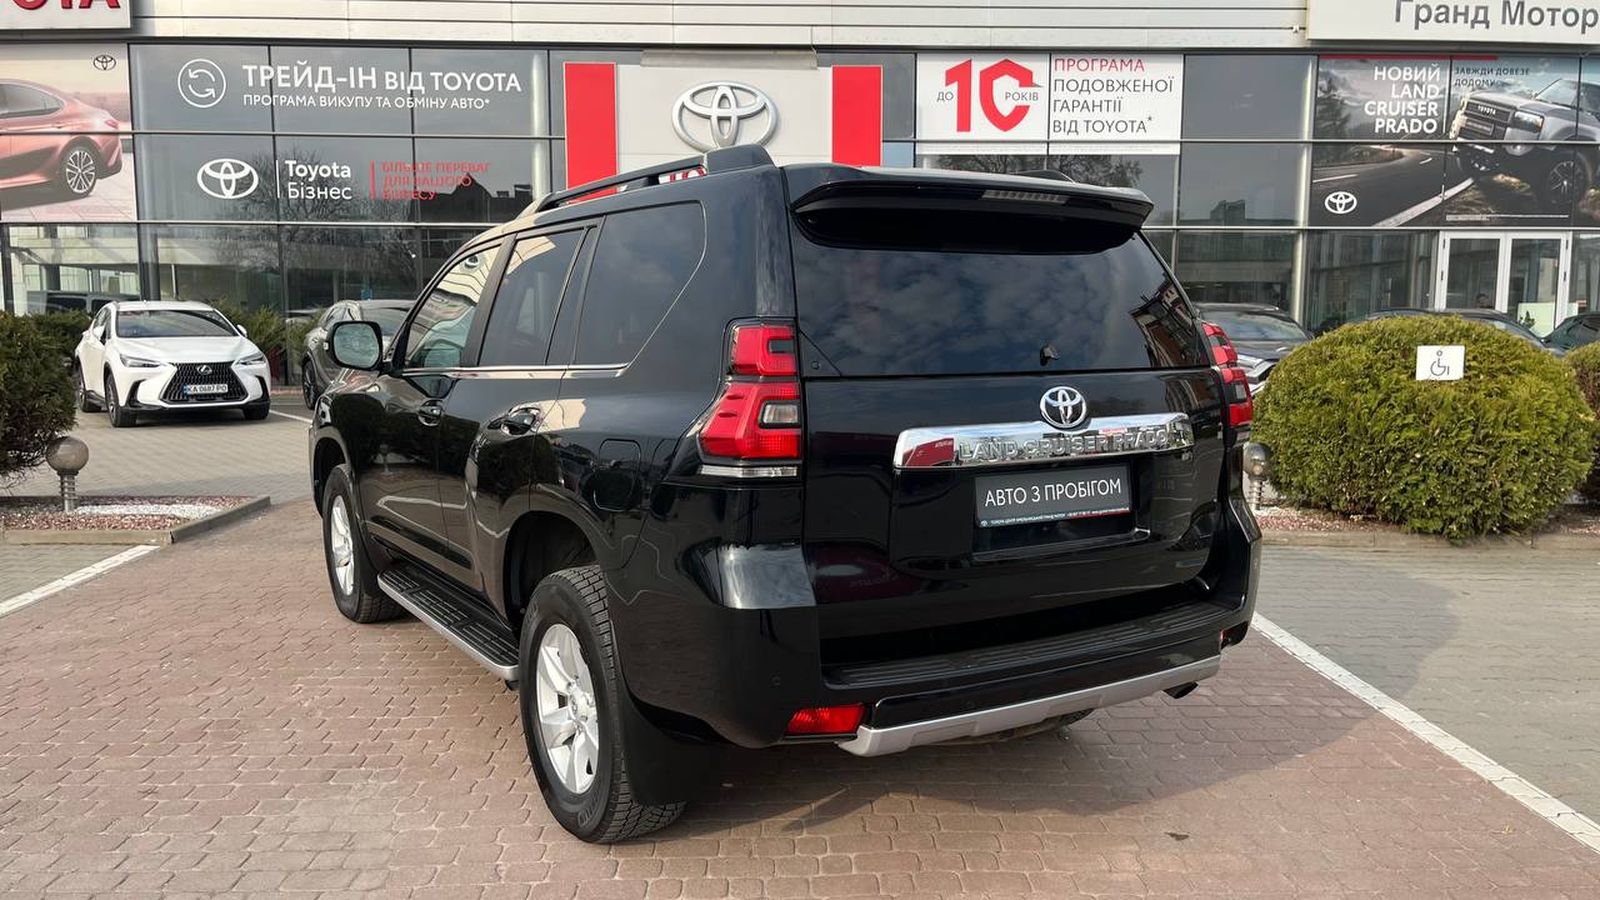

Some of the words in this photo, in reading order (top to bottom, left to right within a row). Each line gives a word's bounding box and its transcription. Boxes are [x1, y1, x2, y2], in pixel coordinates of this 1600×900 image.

[1395, 0, 1490, 30] Гранд
[1054, 58, 1145, 72] ПРОГРАМА
[1374, 63, 1441, 81] НОВИЙ
[1455, 67, 1494, 76] ЗАВЖДИ
[242, 60, 377, 93] ТРЕЙД-ІН
[385, 71, 425, 94] ВІД
[430, 72, 522, 92] TOYOTA
[1053, 76, 1175, 93] ПОДОВЖЕНОЇ
[937, 92, 954, 102] ДО
[1005, 92, 1039, 101] РОКІВ
[1391, 84, 1440, 99] LAND
[243, 95, 317, 107] ПРОГРАМА
[320, 96, 373, 108] ВИКУПУ
[376, 97, 392, 108] ТА
[394, 97, 447, 109] ОБМІНУ
[1053, 97, 1123, 113] ГАРАНТІЇ
[1364, 101, 1439, 117] CRUISER
[1053, 120, 1078, 135] ВІД
[1374, 118, 1438, 134] PRADO
[285, 160, 351, 181] Toyota
[287, 182, 352, 201] Бізнес
[959, 440, 1018, 461] LAND
[1022, 433, 1108, 455] CRUISER
[1114, 429, 1167, 450] PRADO
[984, 486, 1027, 507] АВТО
[1044, 477, 1122, 501] ПРОБІГОМ
